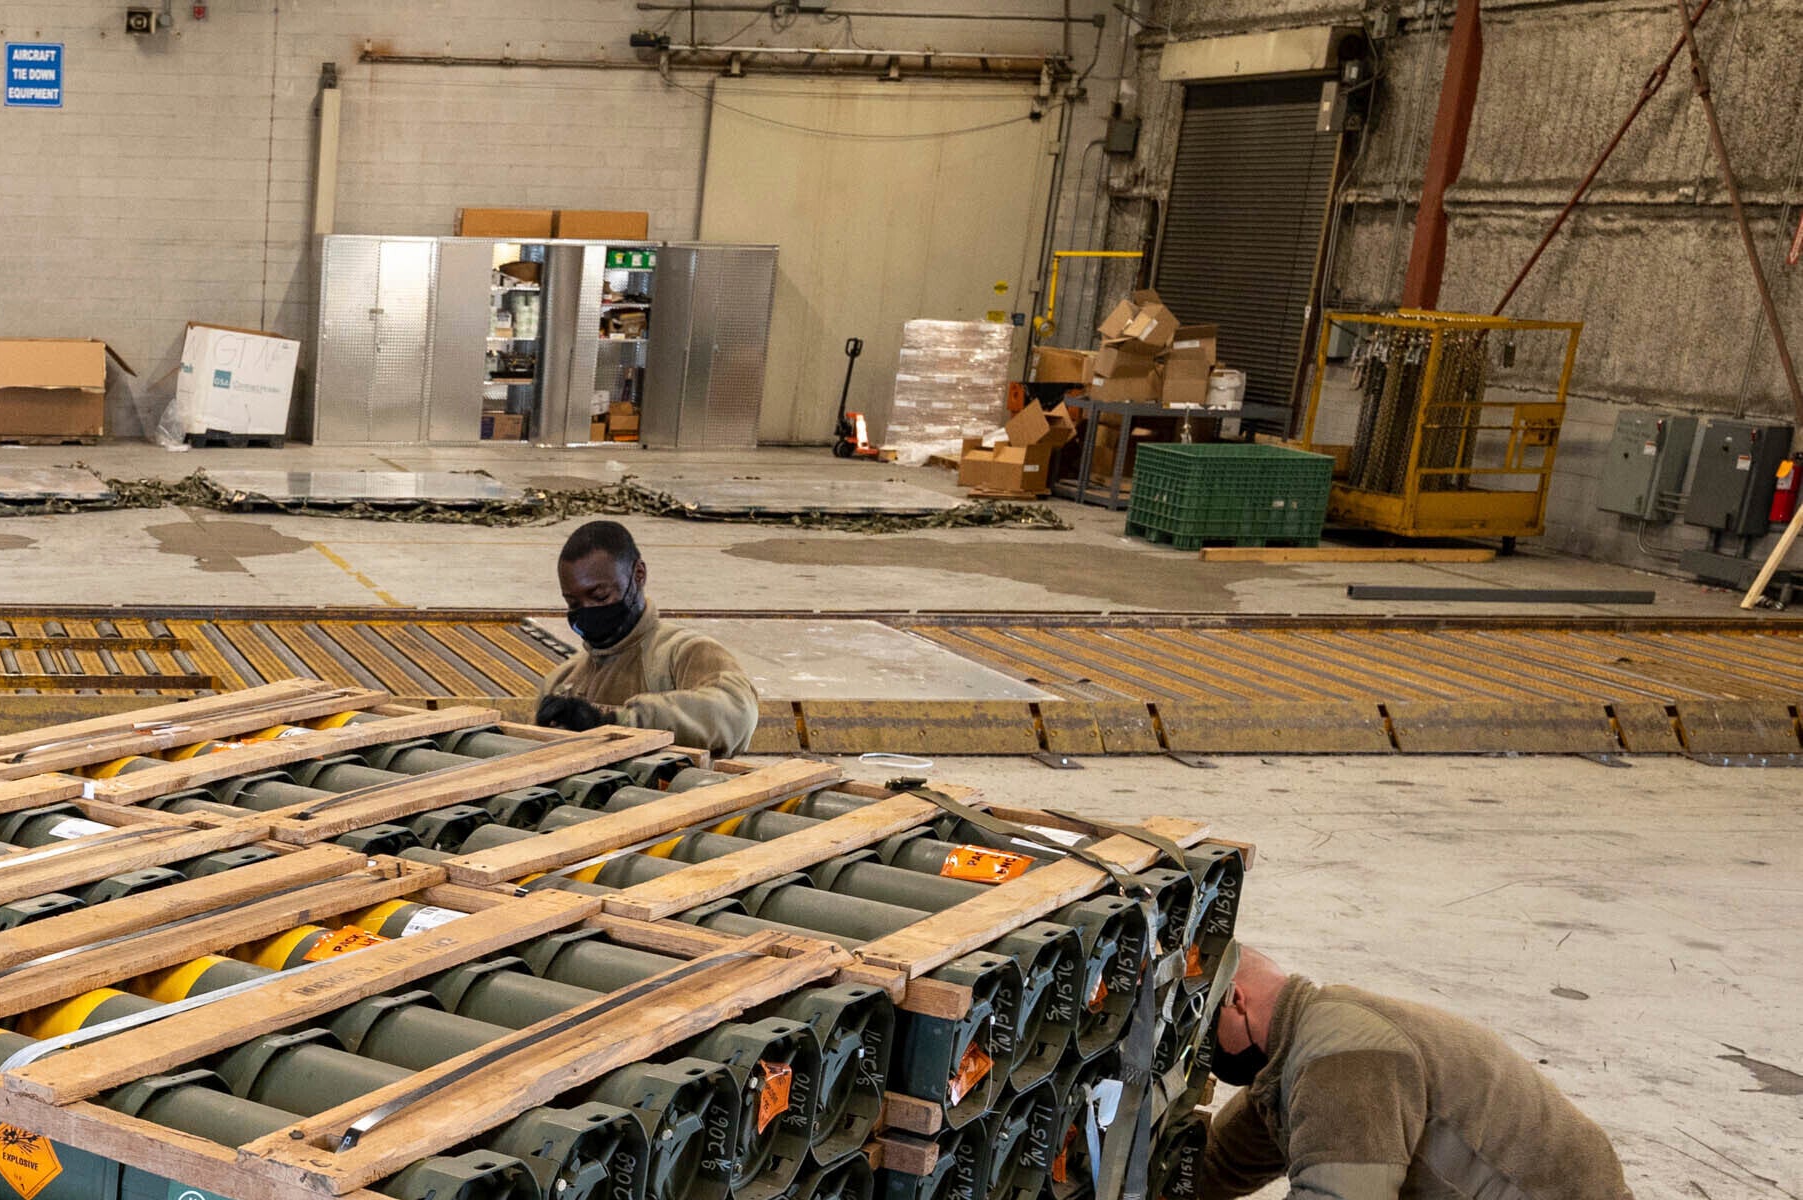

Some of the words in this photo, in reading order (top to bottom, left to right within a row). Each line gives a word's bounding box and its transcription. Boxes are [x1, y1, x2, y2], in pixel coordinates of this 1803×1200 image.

[12, 49, 56, 61] AIRCRAFT
[12, 68, 27, 80] TIE
[29, 69, 56, 80] DOWN
[8, 87, 59, 99] EQUIPMENT
[1056, 959, 1075, 1002] 1576
[861, 1028, 882, 1072] 2071
[789, 1072, 811, 1112] 2070
[707, 1104, 730, 1156] 2069
[1030, 1104, 1053, 1150] 1571
[2, 1150, 39, 1172] EXPLOSIVE
[957, 1143, 975, 1182] 1570
